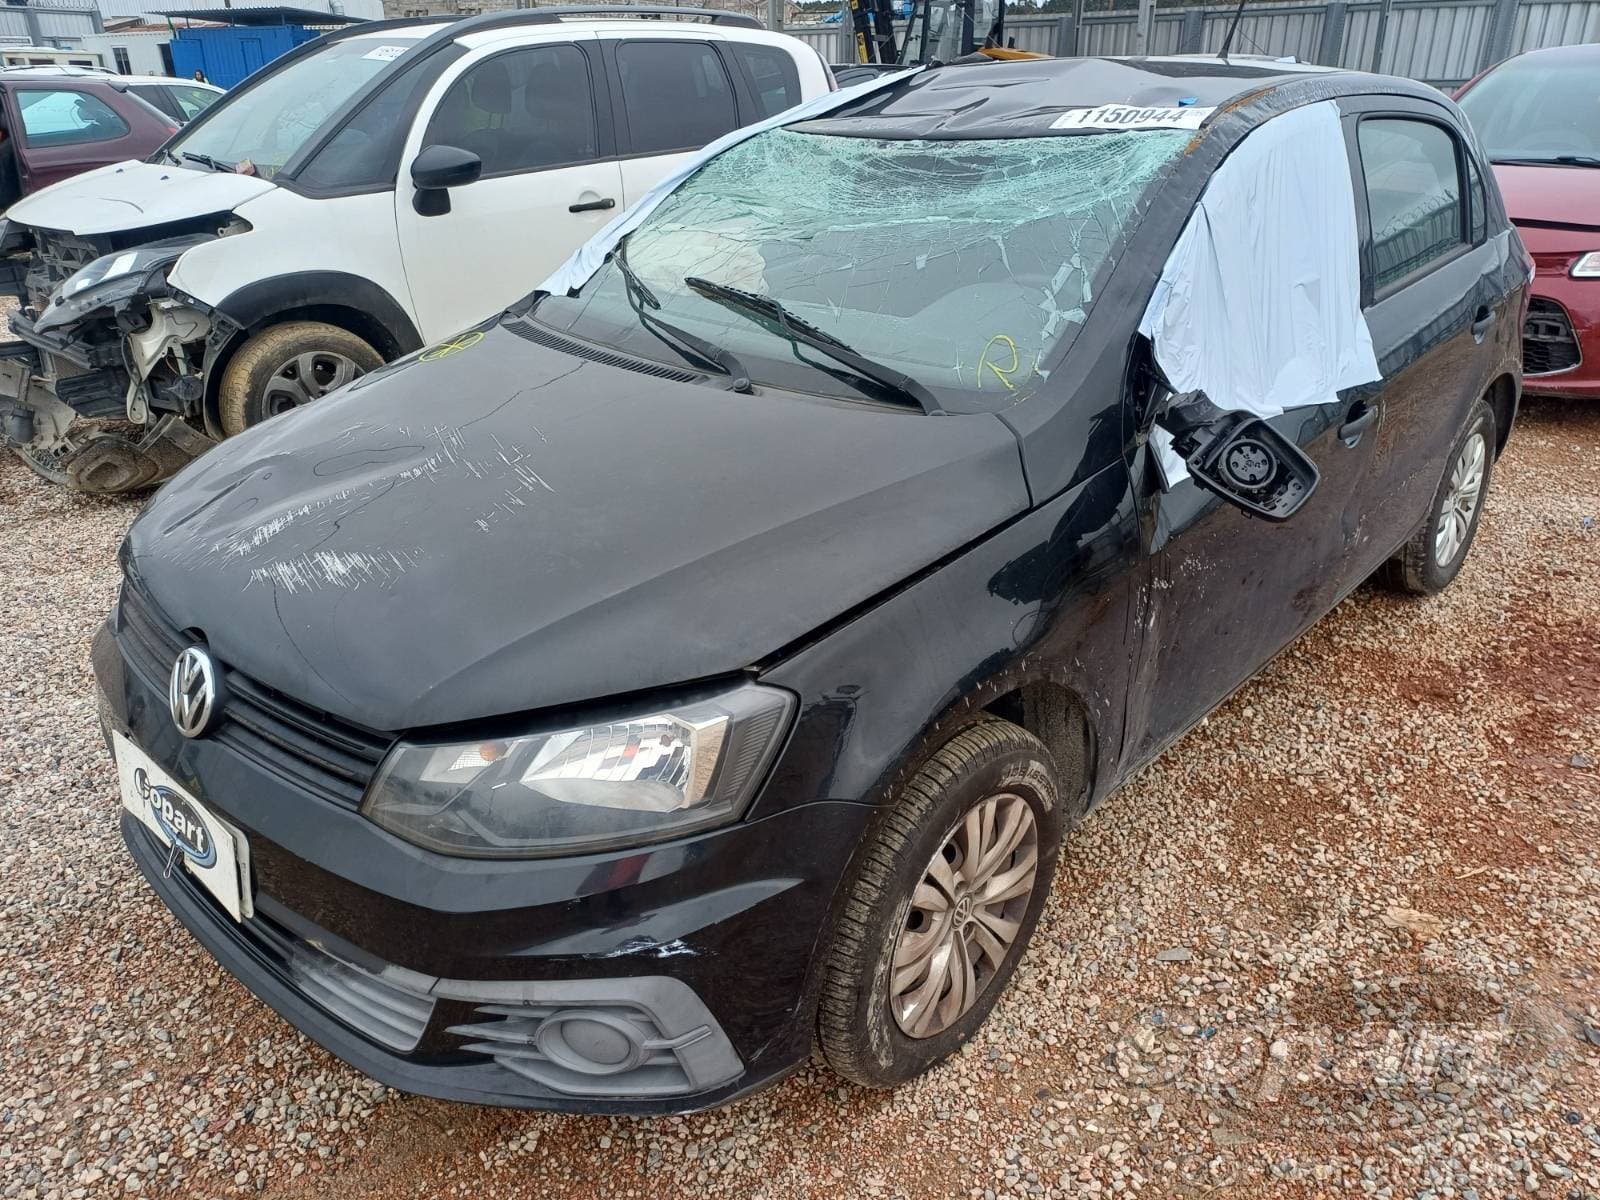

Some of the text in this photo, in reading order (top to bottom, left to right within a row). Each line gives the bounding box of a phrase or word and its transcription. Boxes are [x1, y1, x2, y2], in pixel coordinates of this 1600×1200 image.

[1078, 107, 1187, 124] 1150944
[977, 334, 1018, 391] R
[133, 767, 206, 854] Copart
